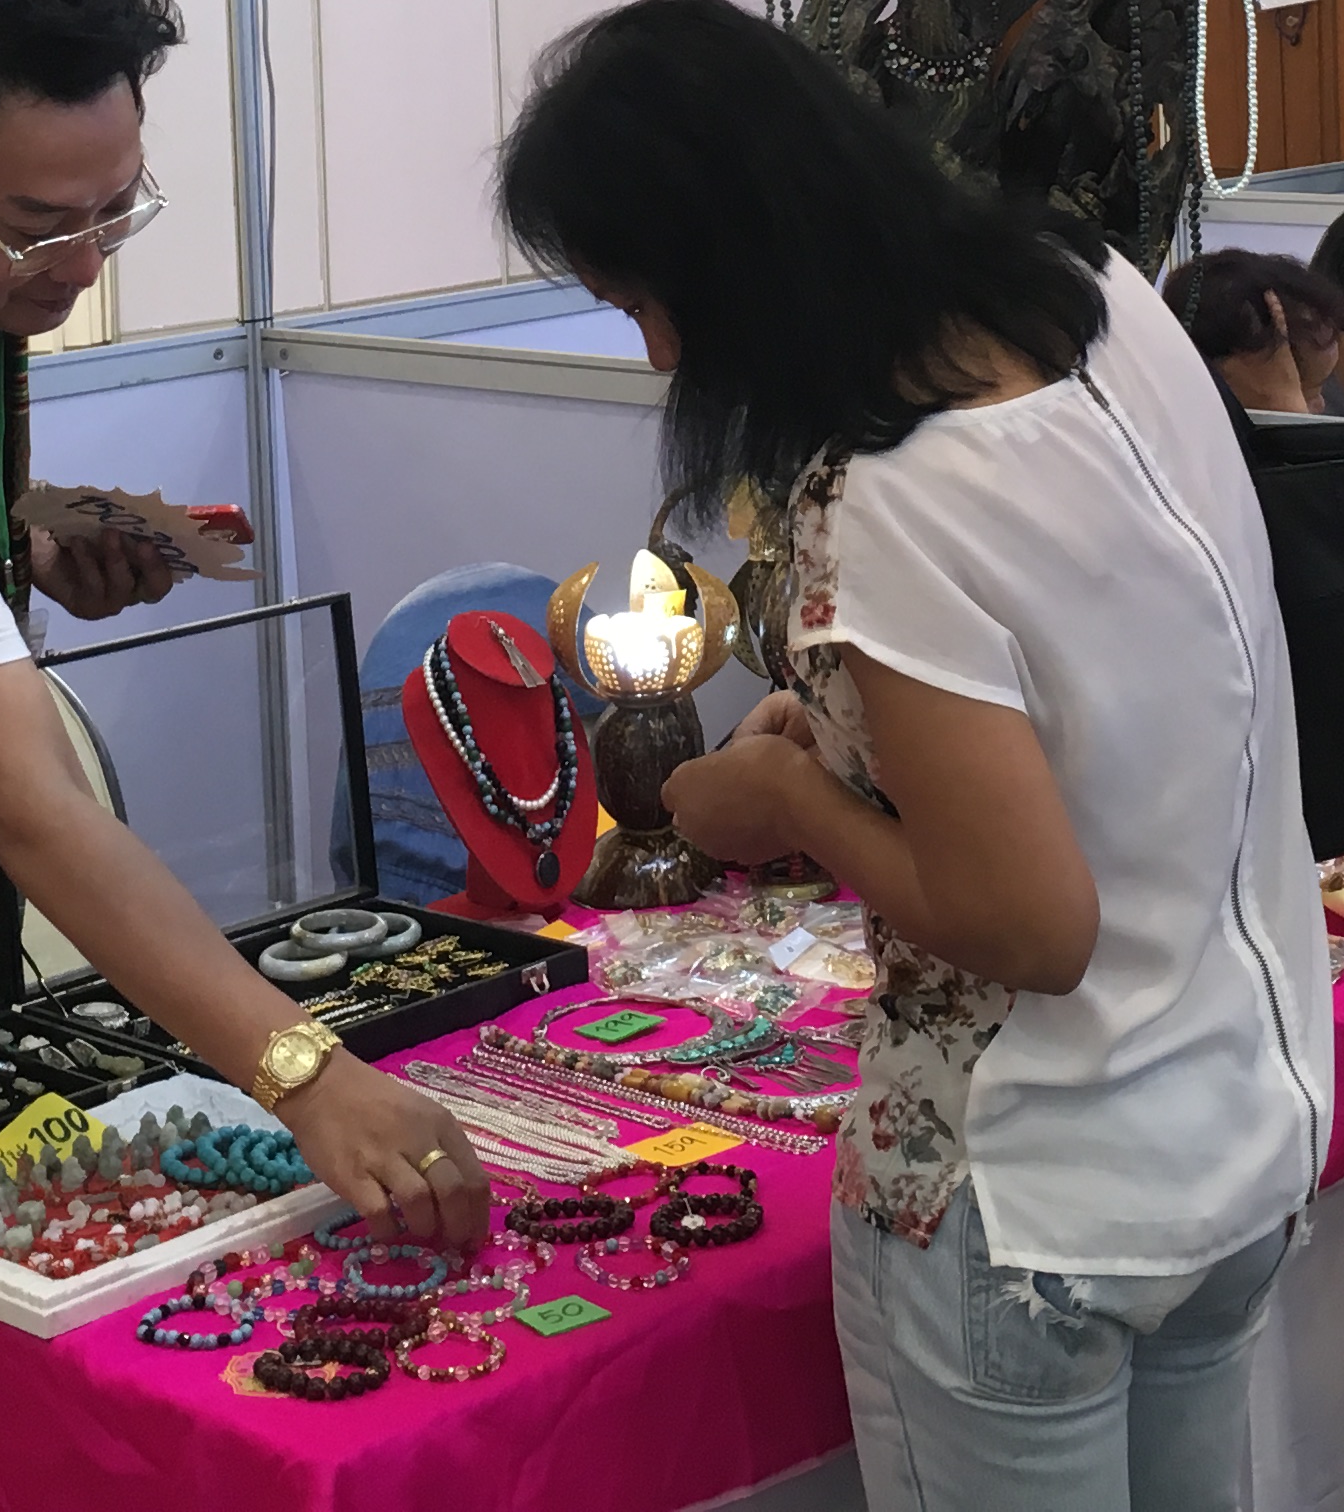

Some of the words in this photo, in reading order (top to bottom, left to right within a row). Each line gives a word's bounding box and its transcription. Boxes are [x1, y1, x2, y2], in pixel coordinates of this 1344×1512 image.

[595, 1011, 649, 1033] 199
[28, 1107, 90, 1152] 100
[652, 1135, 709, 1156] 159
[537, 1301, 584, 1325] 50
